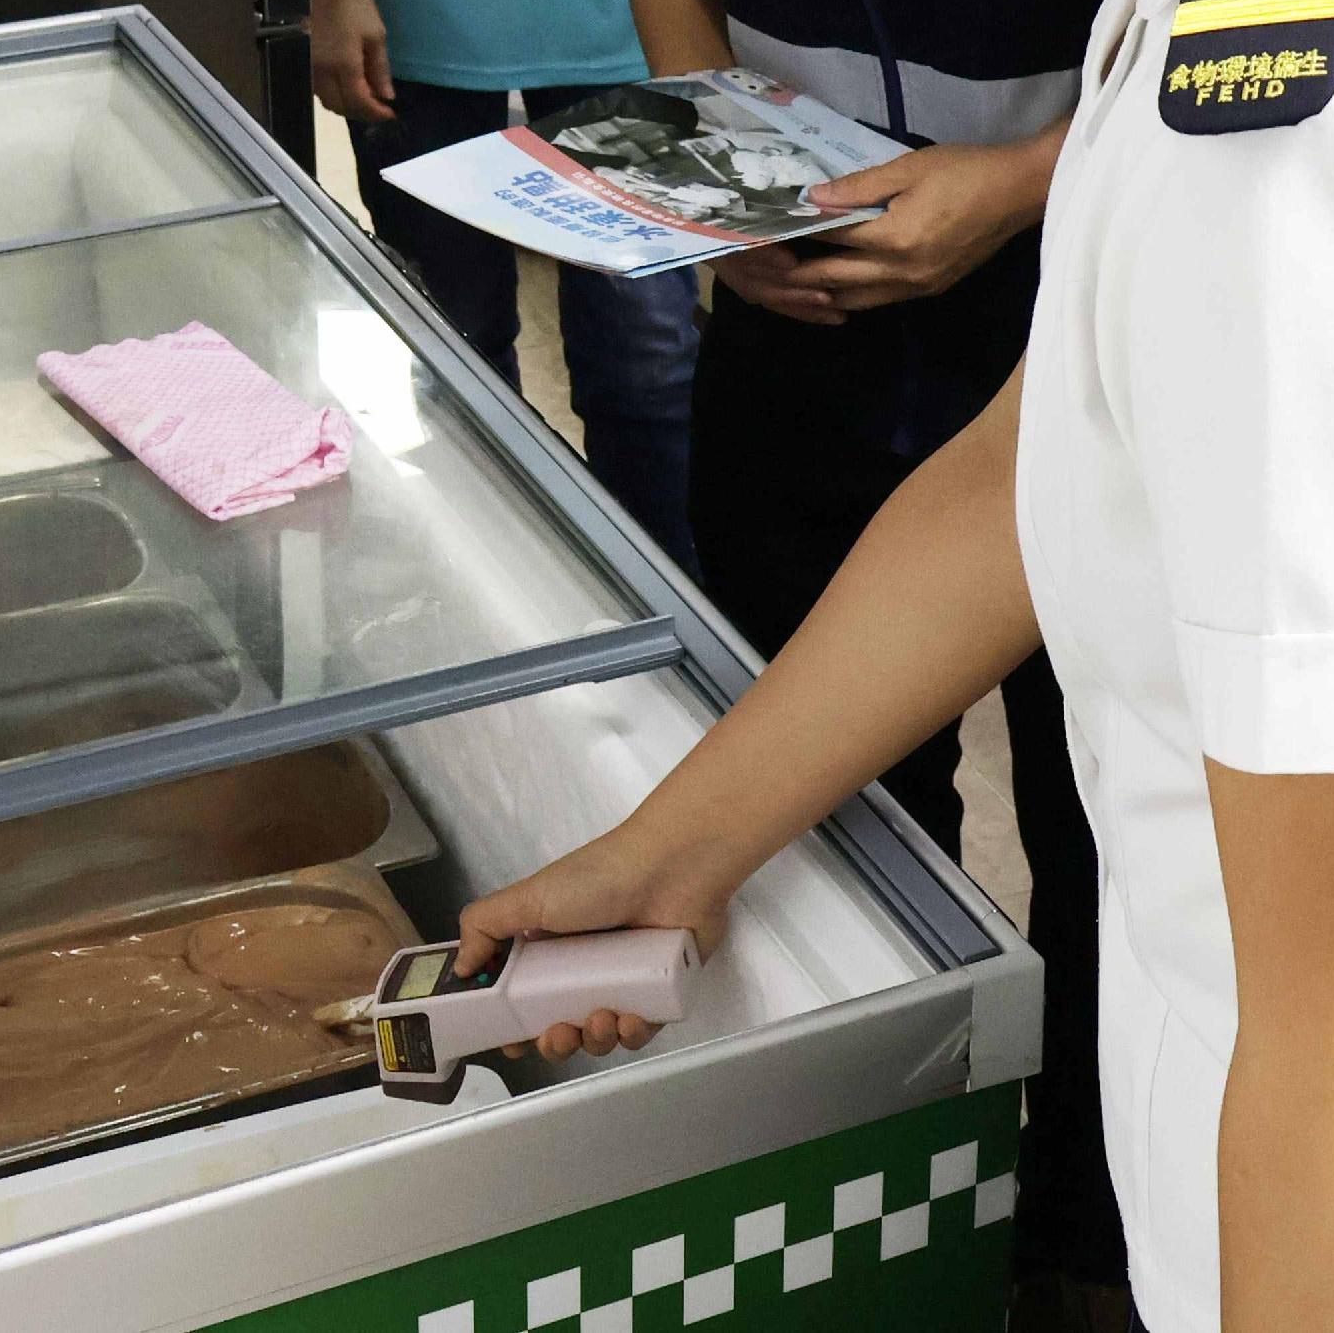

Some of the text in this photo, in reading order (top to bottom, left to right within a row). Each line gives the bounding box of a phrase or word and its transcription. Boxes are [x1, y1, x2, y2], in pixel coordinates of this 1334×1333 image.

[1167, 48, 1328, 93] 食物環境衛生
[1195, 79, 1285, 107] FEHD
